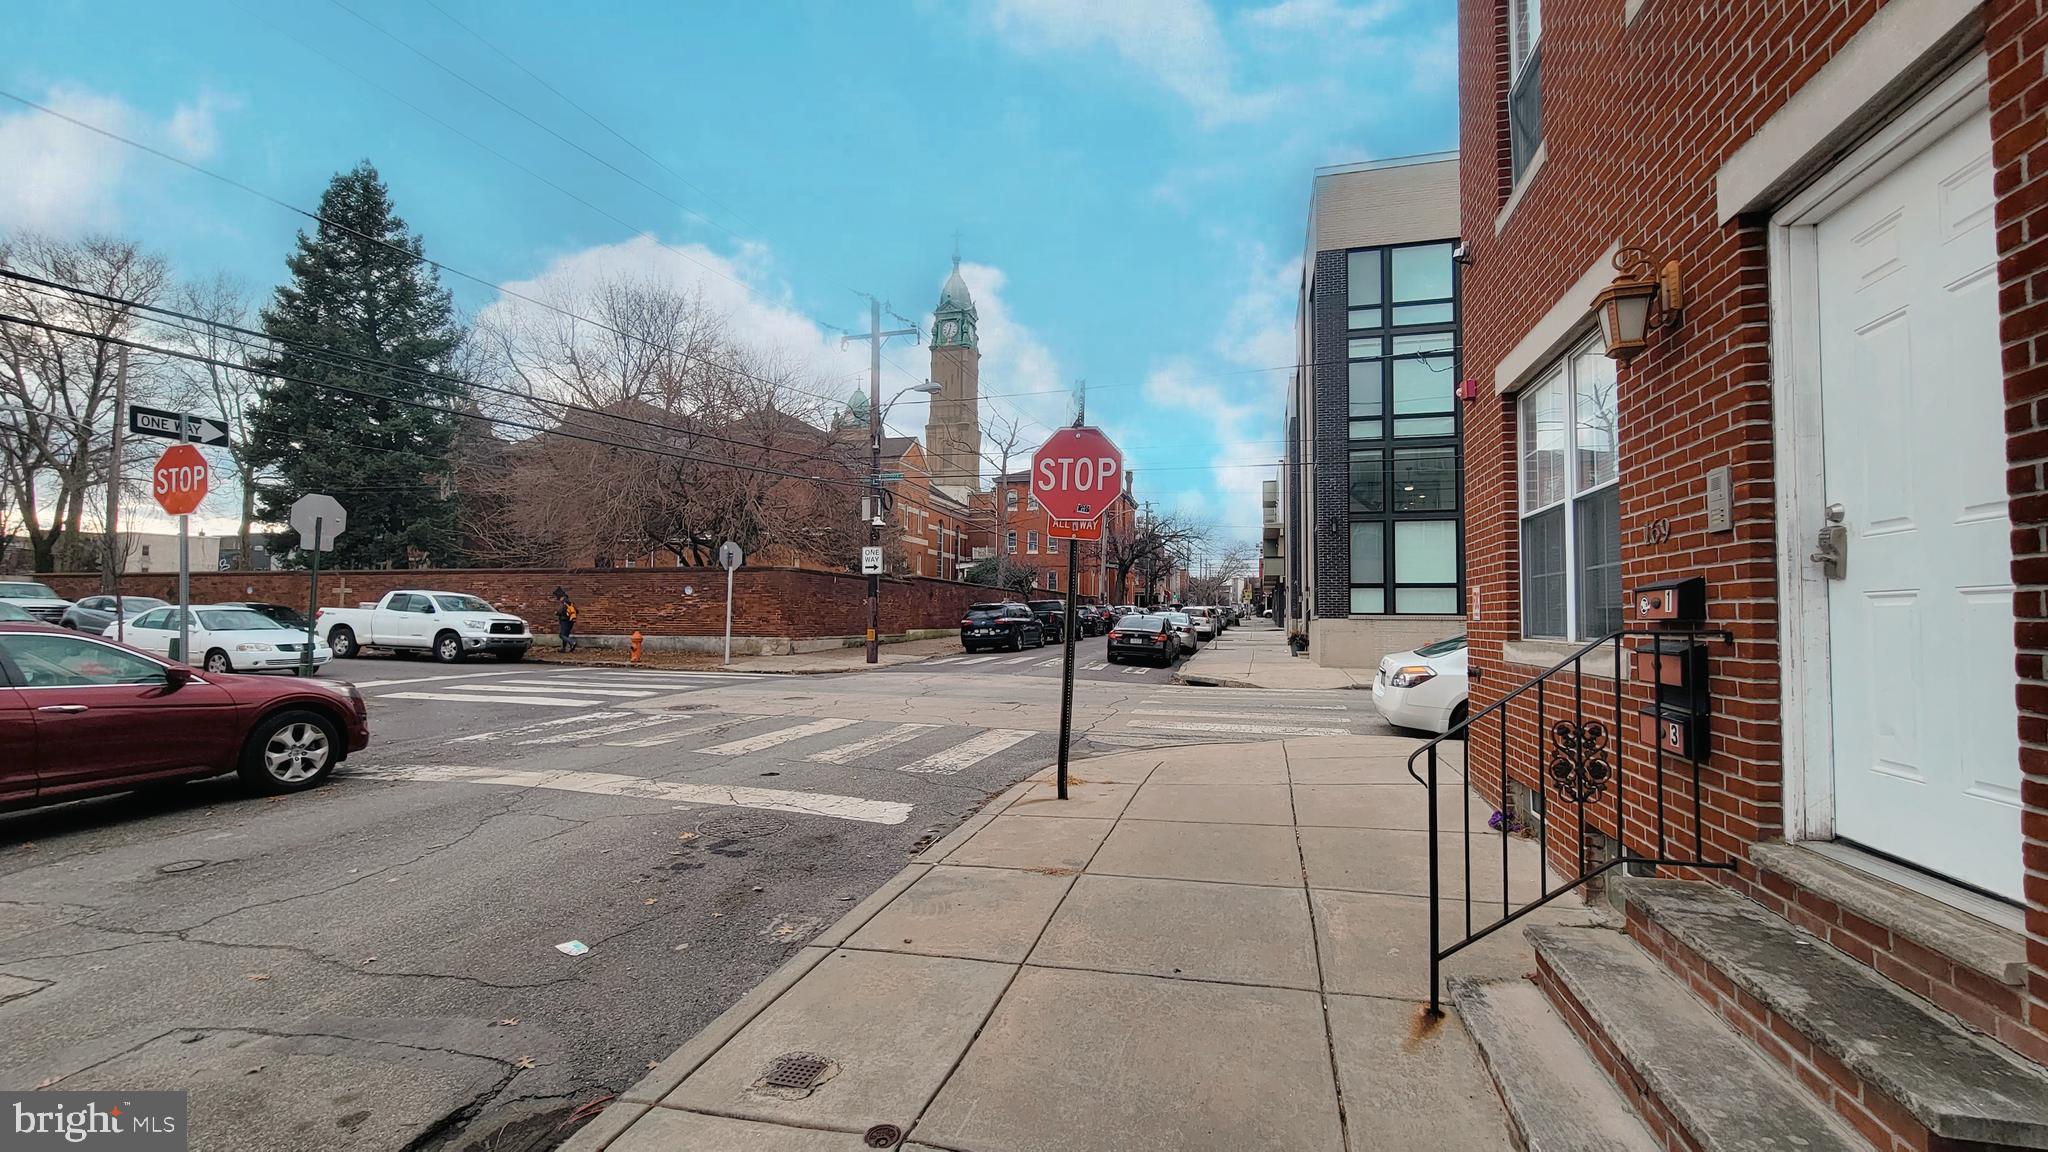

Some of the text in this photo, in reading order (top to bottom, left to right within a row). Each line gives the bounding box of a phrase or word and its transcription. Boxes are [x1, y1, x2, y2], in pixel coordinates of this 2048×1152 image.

[141, 415, 169, 430] ONE
[156, 465, 205, 494] STOP
[1037, 457, 1117, 491] STOP
[1052, 519, 1099, 530] ALL WAY
[1671, 724, 1678, 746] 3
